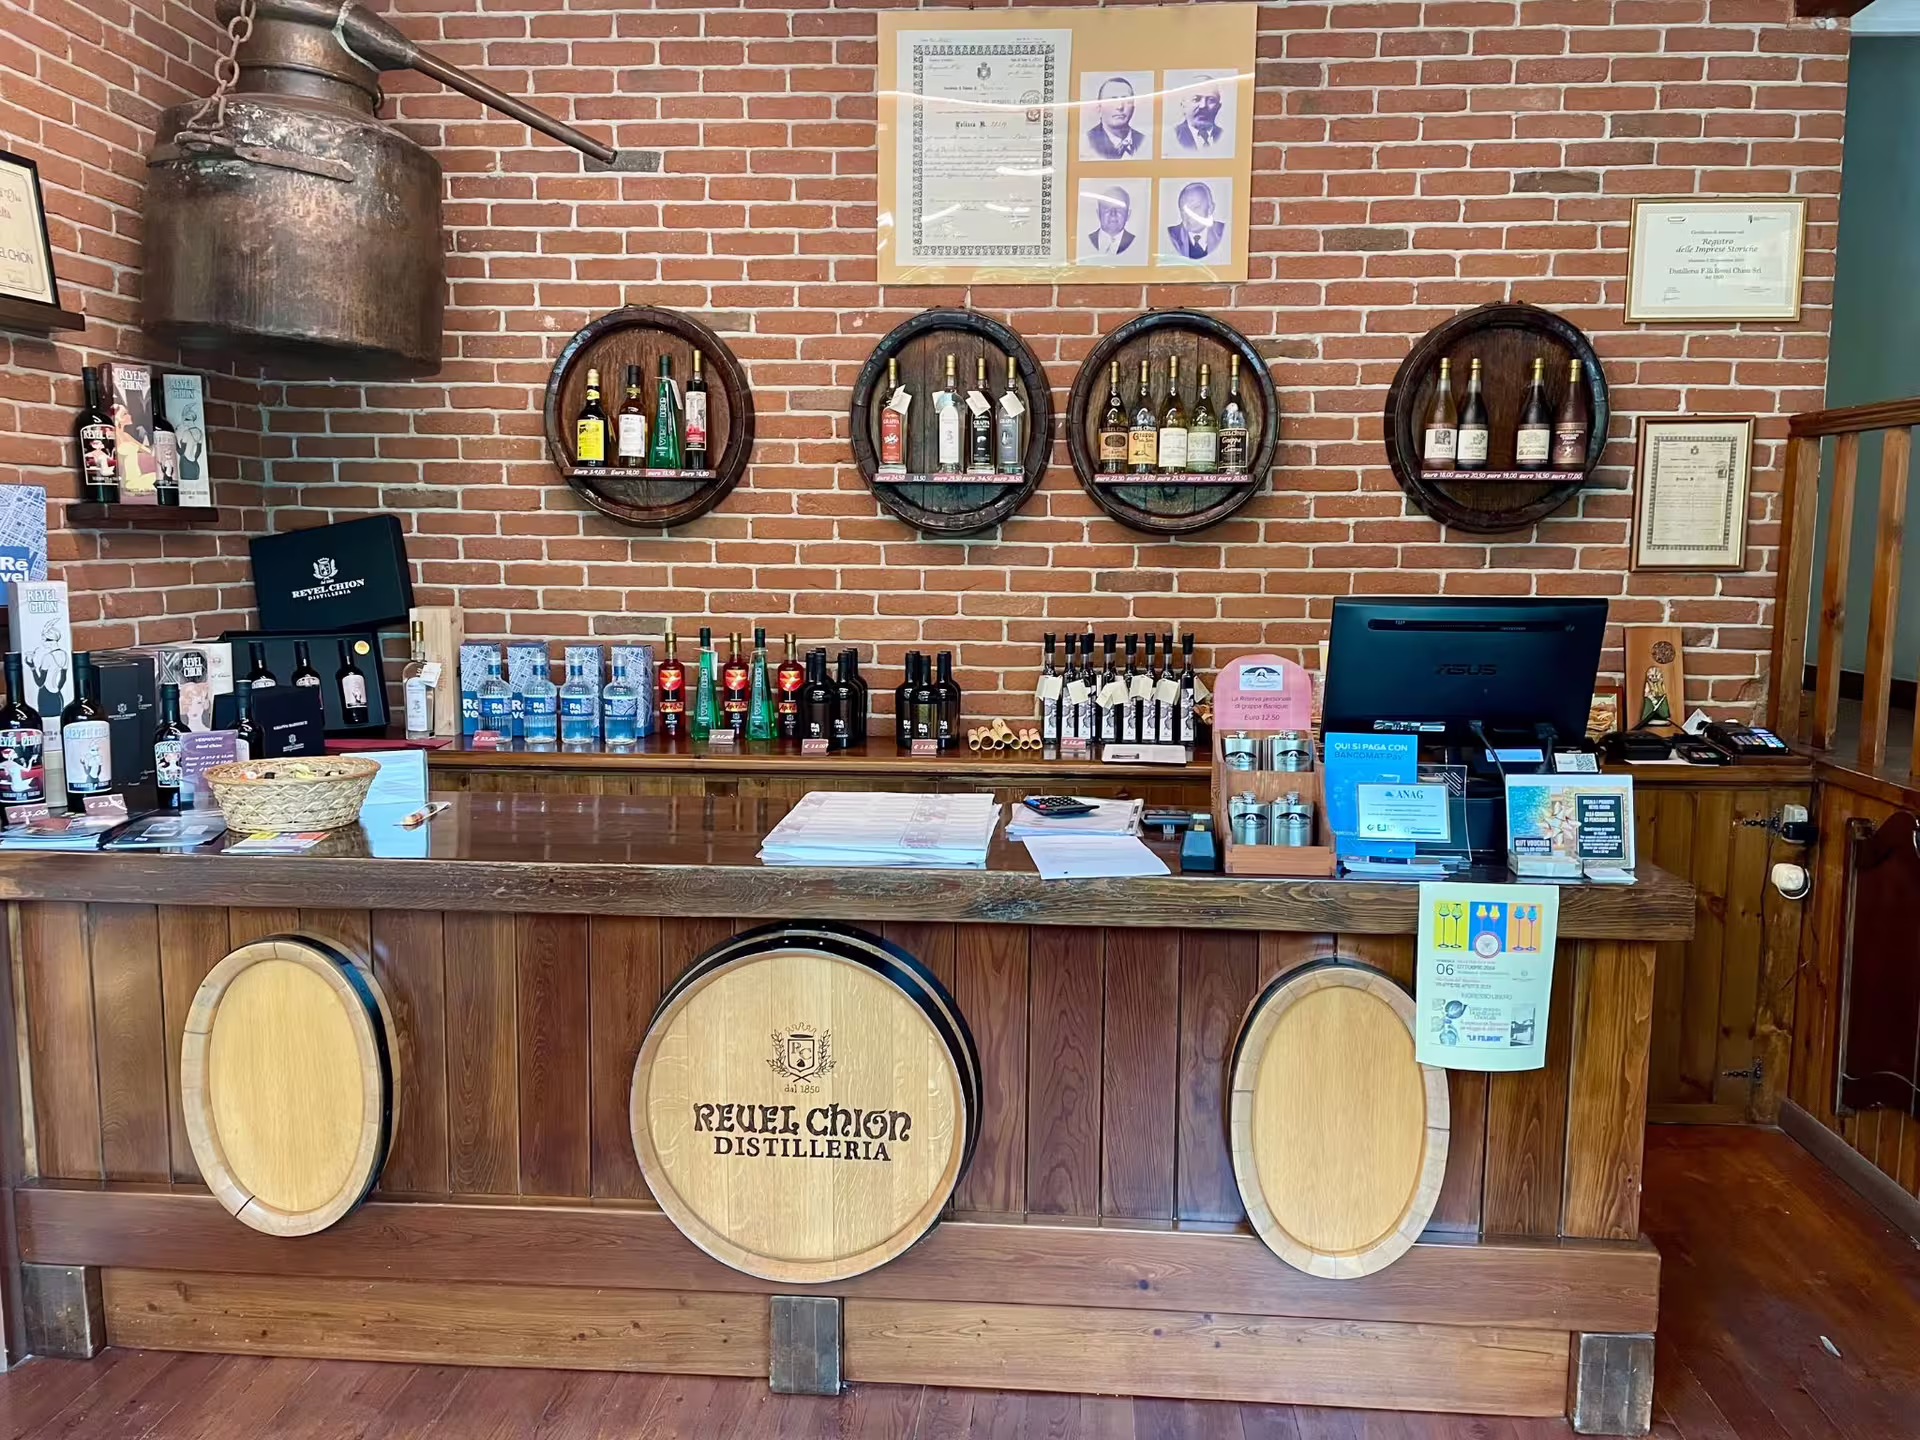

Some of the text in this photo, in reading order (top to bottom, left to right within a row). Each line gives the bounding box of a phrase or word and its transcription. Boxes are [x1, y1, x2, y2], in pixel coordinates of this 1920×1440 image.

[1702, 238, 1735, 247] Registro
[1695, 245, 1726, 254] Imprese
[1727, 245, 1759, 253] Storiche
[328, 578, 365, 593] CHION
[27, 588, 58, 601] REVEL
[307, 589, 352, 601] DISTILLERIA
[28, 601, 59, 614] CHION
[182, 657, 203, 668] REVEL
[183, 667, 203, 678] CHION
[1436, 663, 1497, 676] ASUS
[462, 710, 479, 719] ve
[1334, 742, 1408, 752] QUI SI PAGA CON
[1334, 751, 1386, 760] BANCOMAT
[1396, 789, 1424, 800] ANAG
[1515, 839, 1526, 847] GIFT
[1436, 963, 1454, 976] 06
[784, 1083, 820, 1094] dal 1850
[713, 1136, 892, 1162] DISTILLERIA
